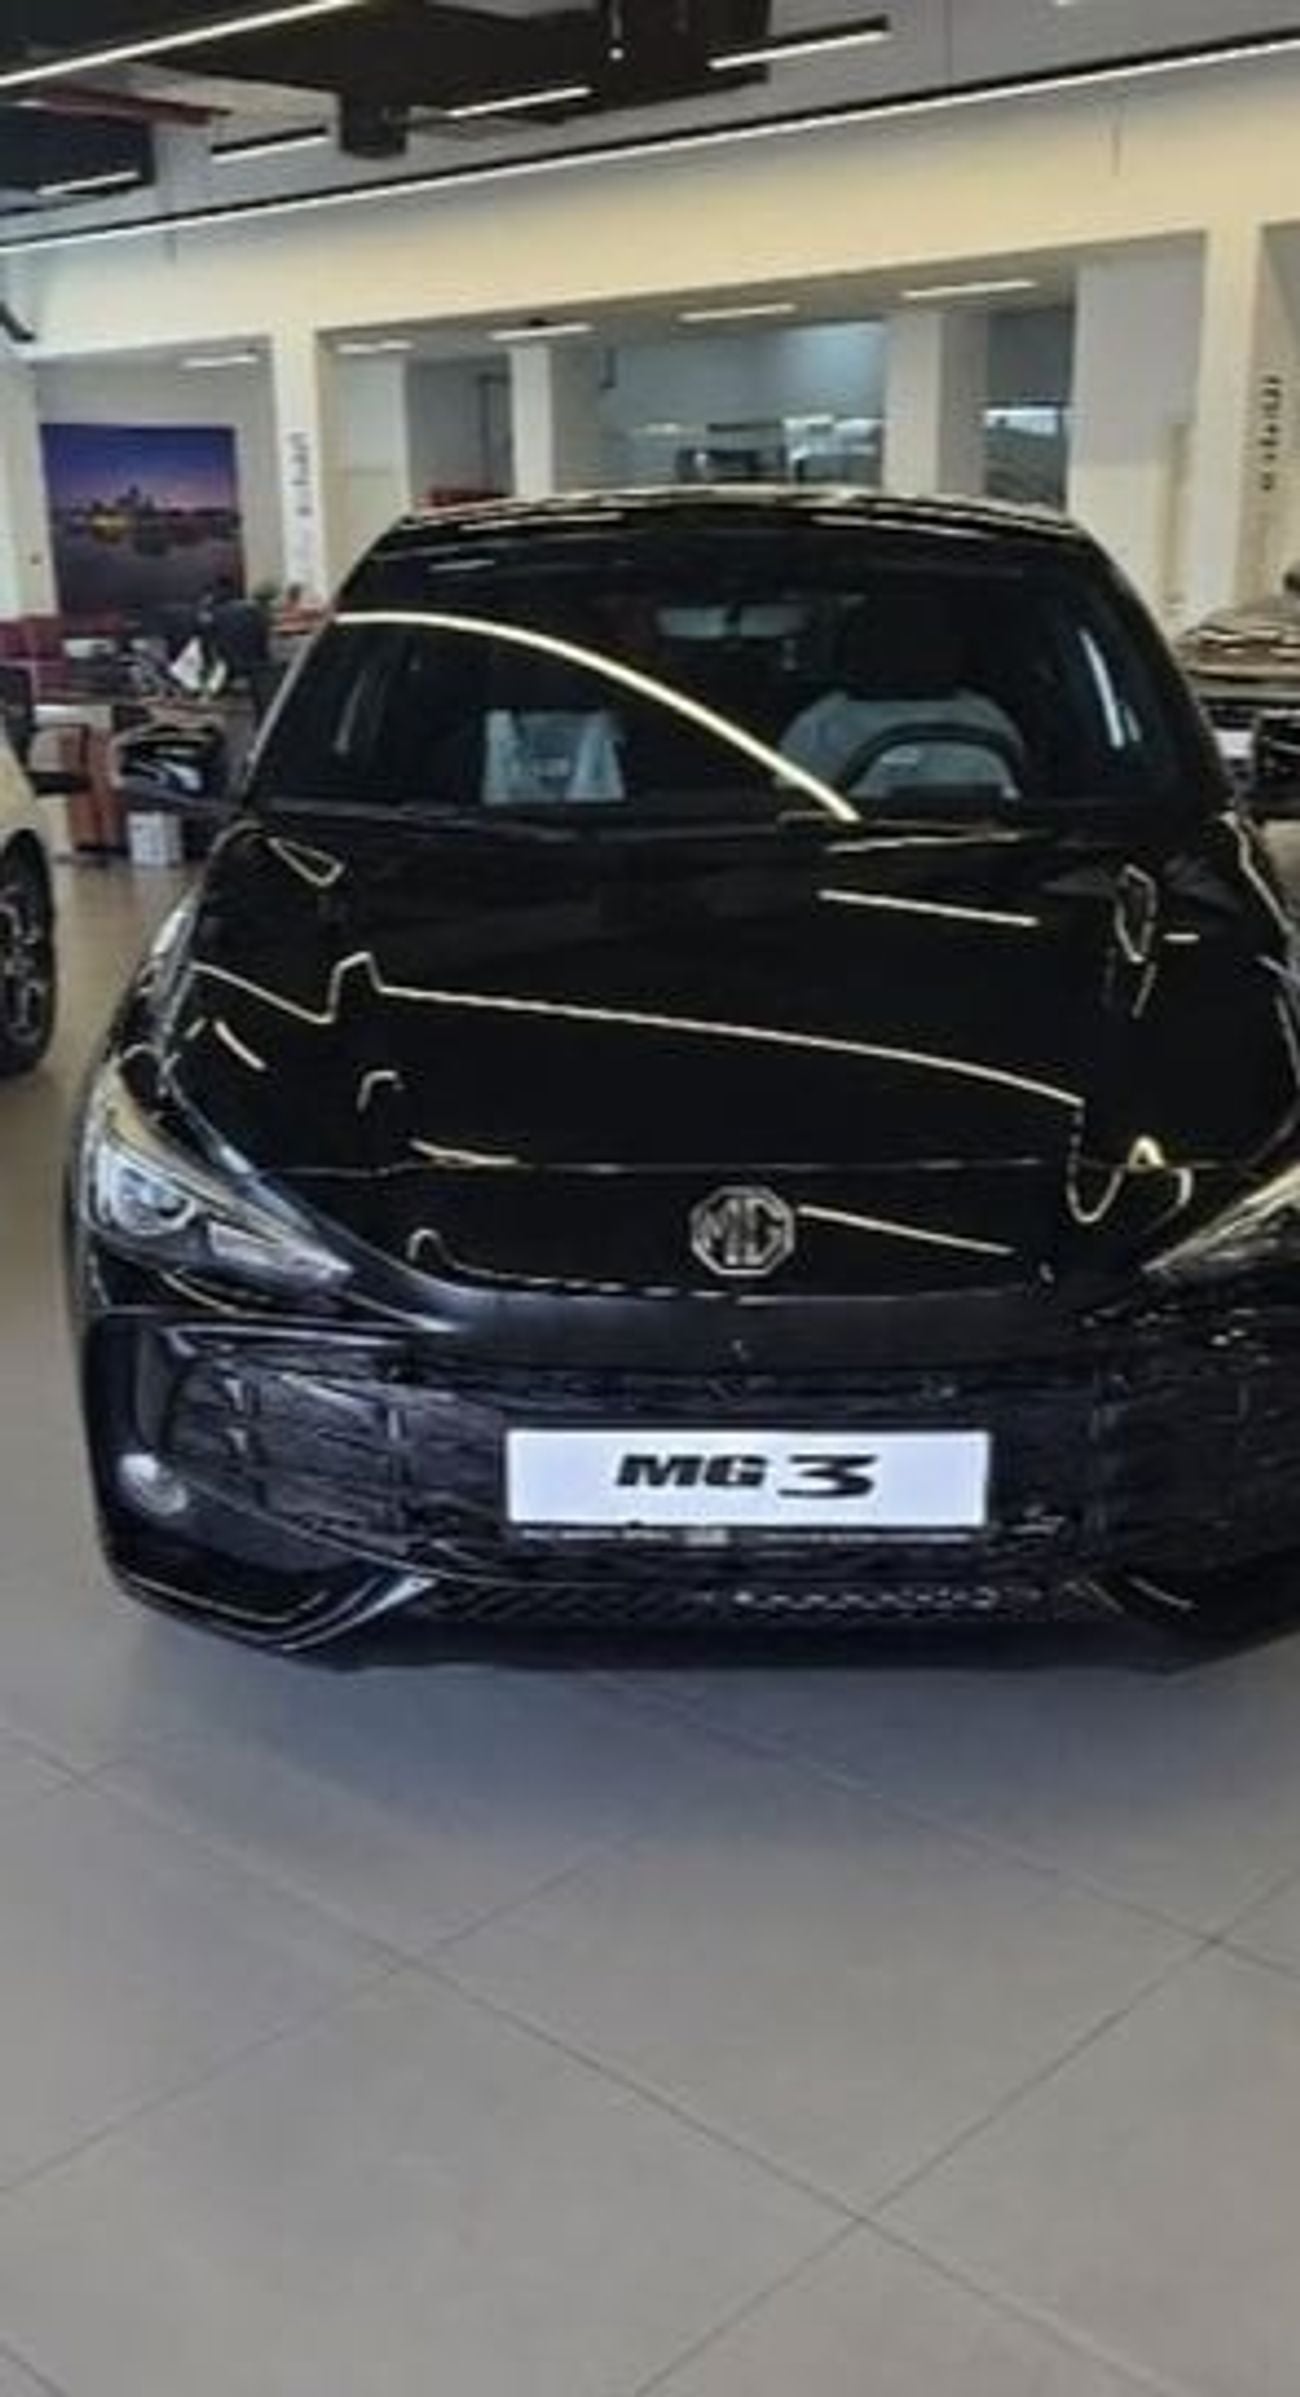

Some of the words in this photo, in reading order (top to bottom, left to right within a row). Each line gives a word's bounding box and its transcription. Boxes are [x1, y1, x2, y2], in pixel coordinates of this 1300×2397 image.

[695, 1191, 792, 1272] MG
[615, 1454, 768, 1488] MG
[776, 1454, 878, 1499] 3
